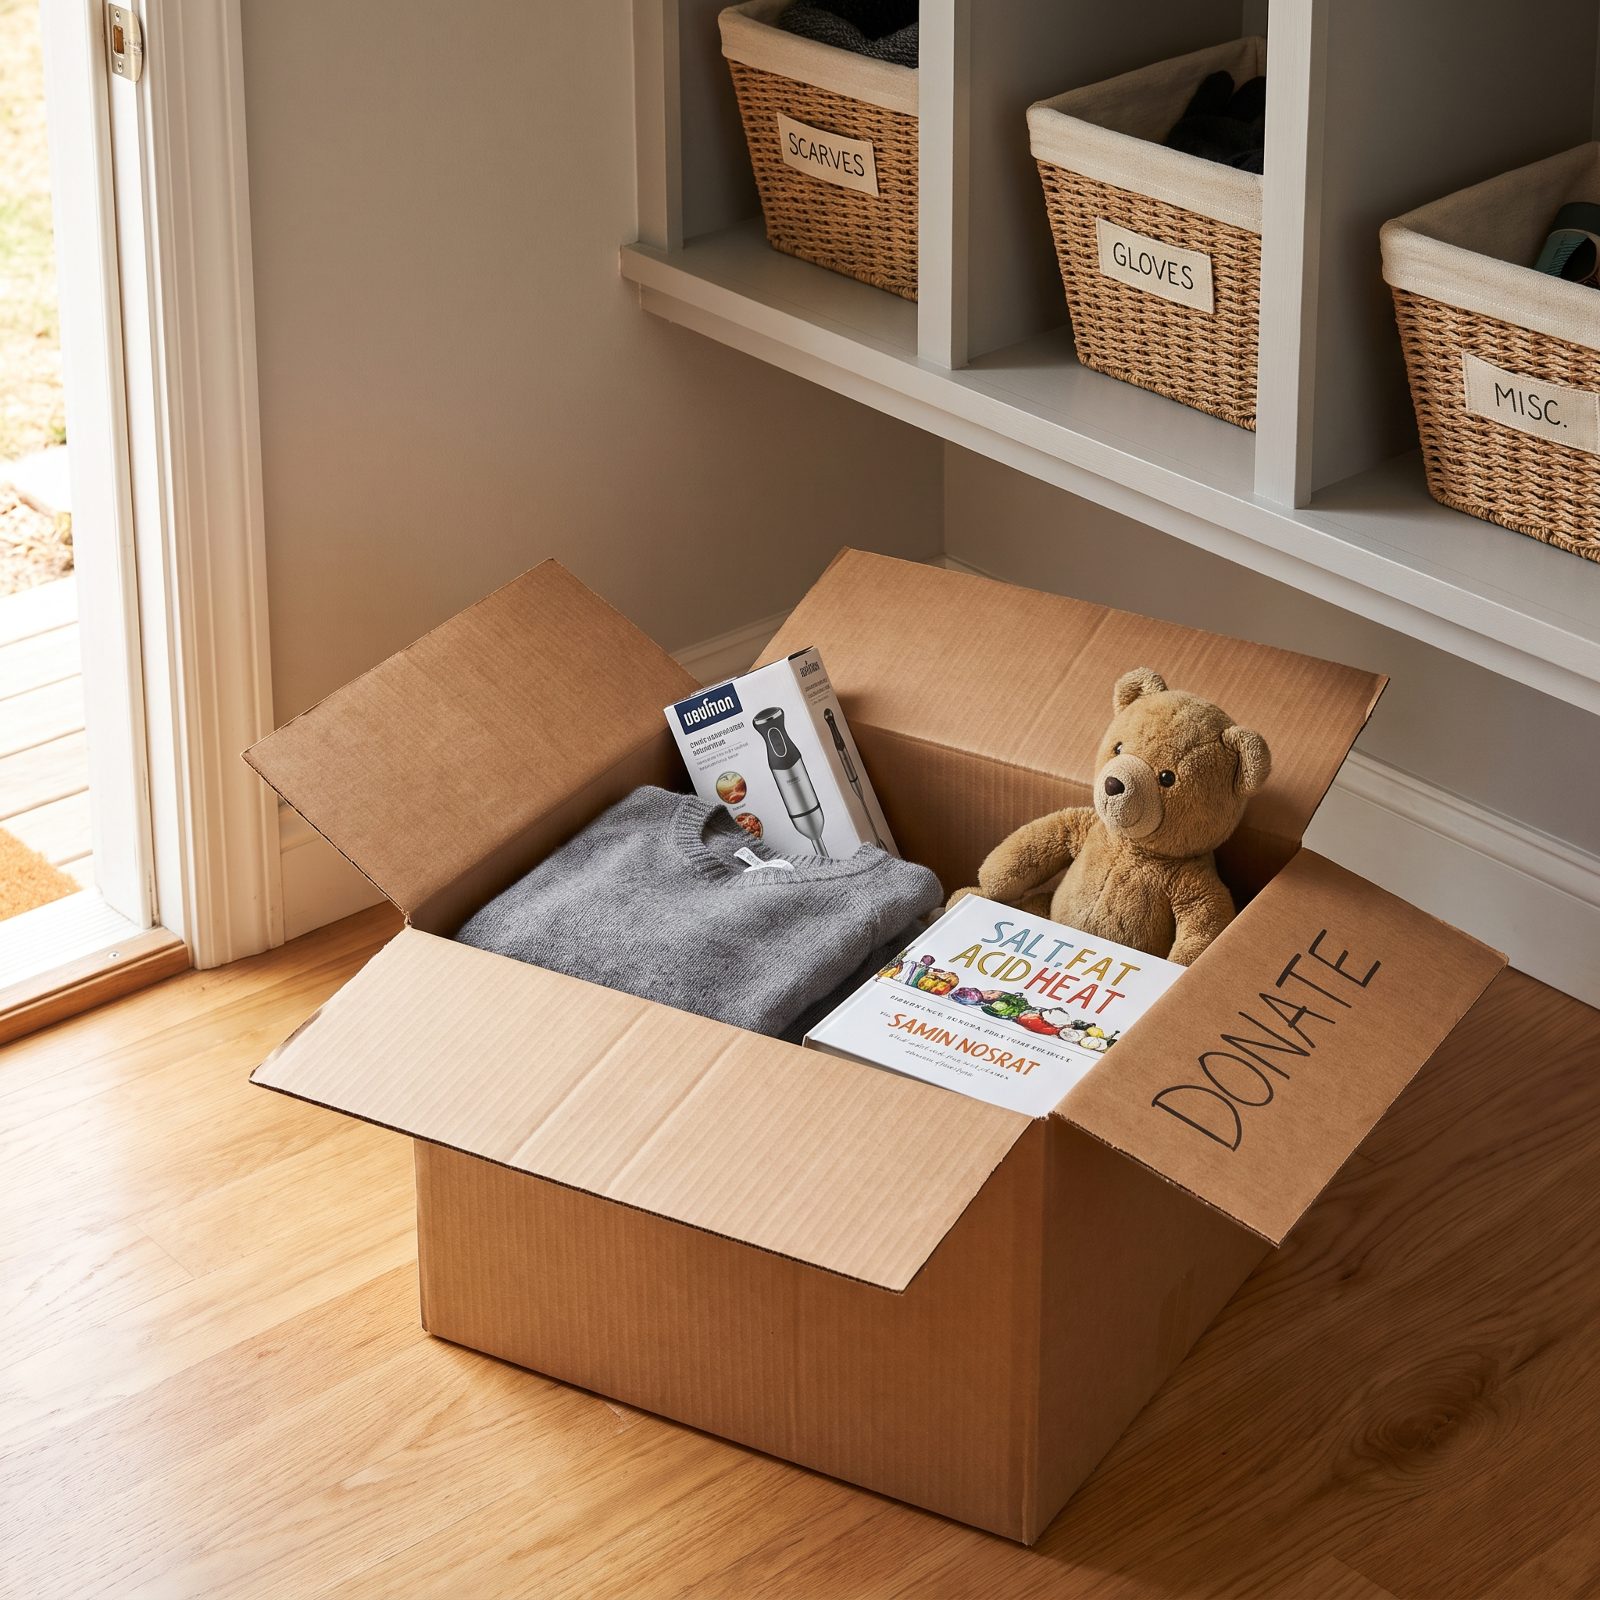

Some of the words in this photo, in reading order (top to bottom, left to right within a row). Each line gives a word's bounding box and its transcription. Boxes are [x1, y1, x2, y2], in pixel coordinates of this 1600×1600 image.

[788, 131, 866, 179] SCARVES
[1112, 241, 1195, 291] GLOVES
[1494, 382, 1568, 429] MISC.
[948, 943, 1032, 982] ACID
[1024, 967, 1126, 1014] HEAT
[1065, 948, 1141, 987] FAT
[887, 1013, 959, 1047] SAMIN
[955, 1037, 1041, 1076] NOSRAT
[1151, 928, 1382, 1152] DONATE
